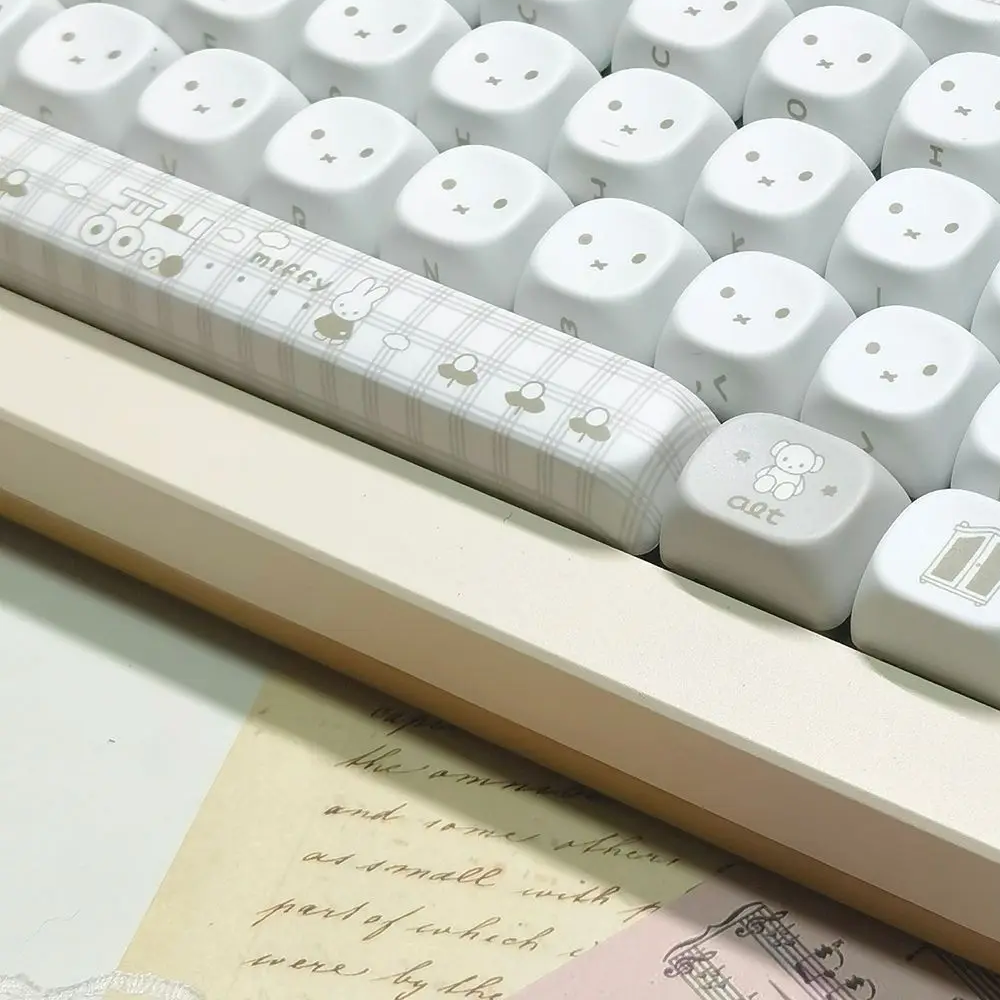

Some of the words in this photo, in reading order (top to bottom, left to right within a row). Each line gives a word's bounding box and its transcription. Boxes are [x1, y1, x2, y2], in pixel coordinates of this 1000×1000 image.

[726, 494, 785, 526] alt
[324, 803, 408, 822] and
[356, 860, 503, 888] small
[408, 916, 556, 952] which
